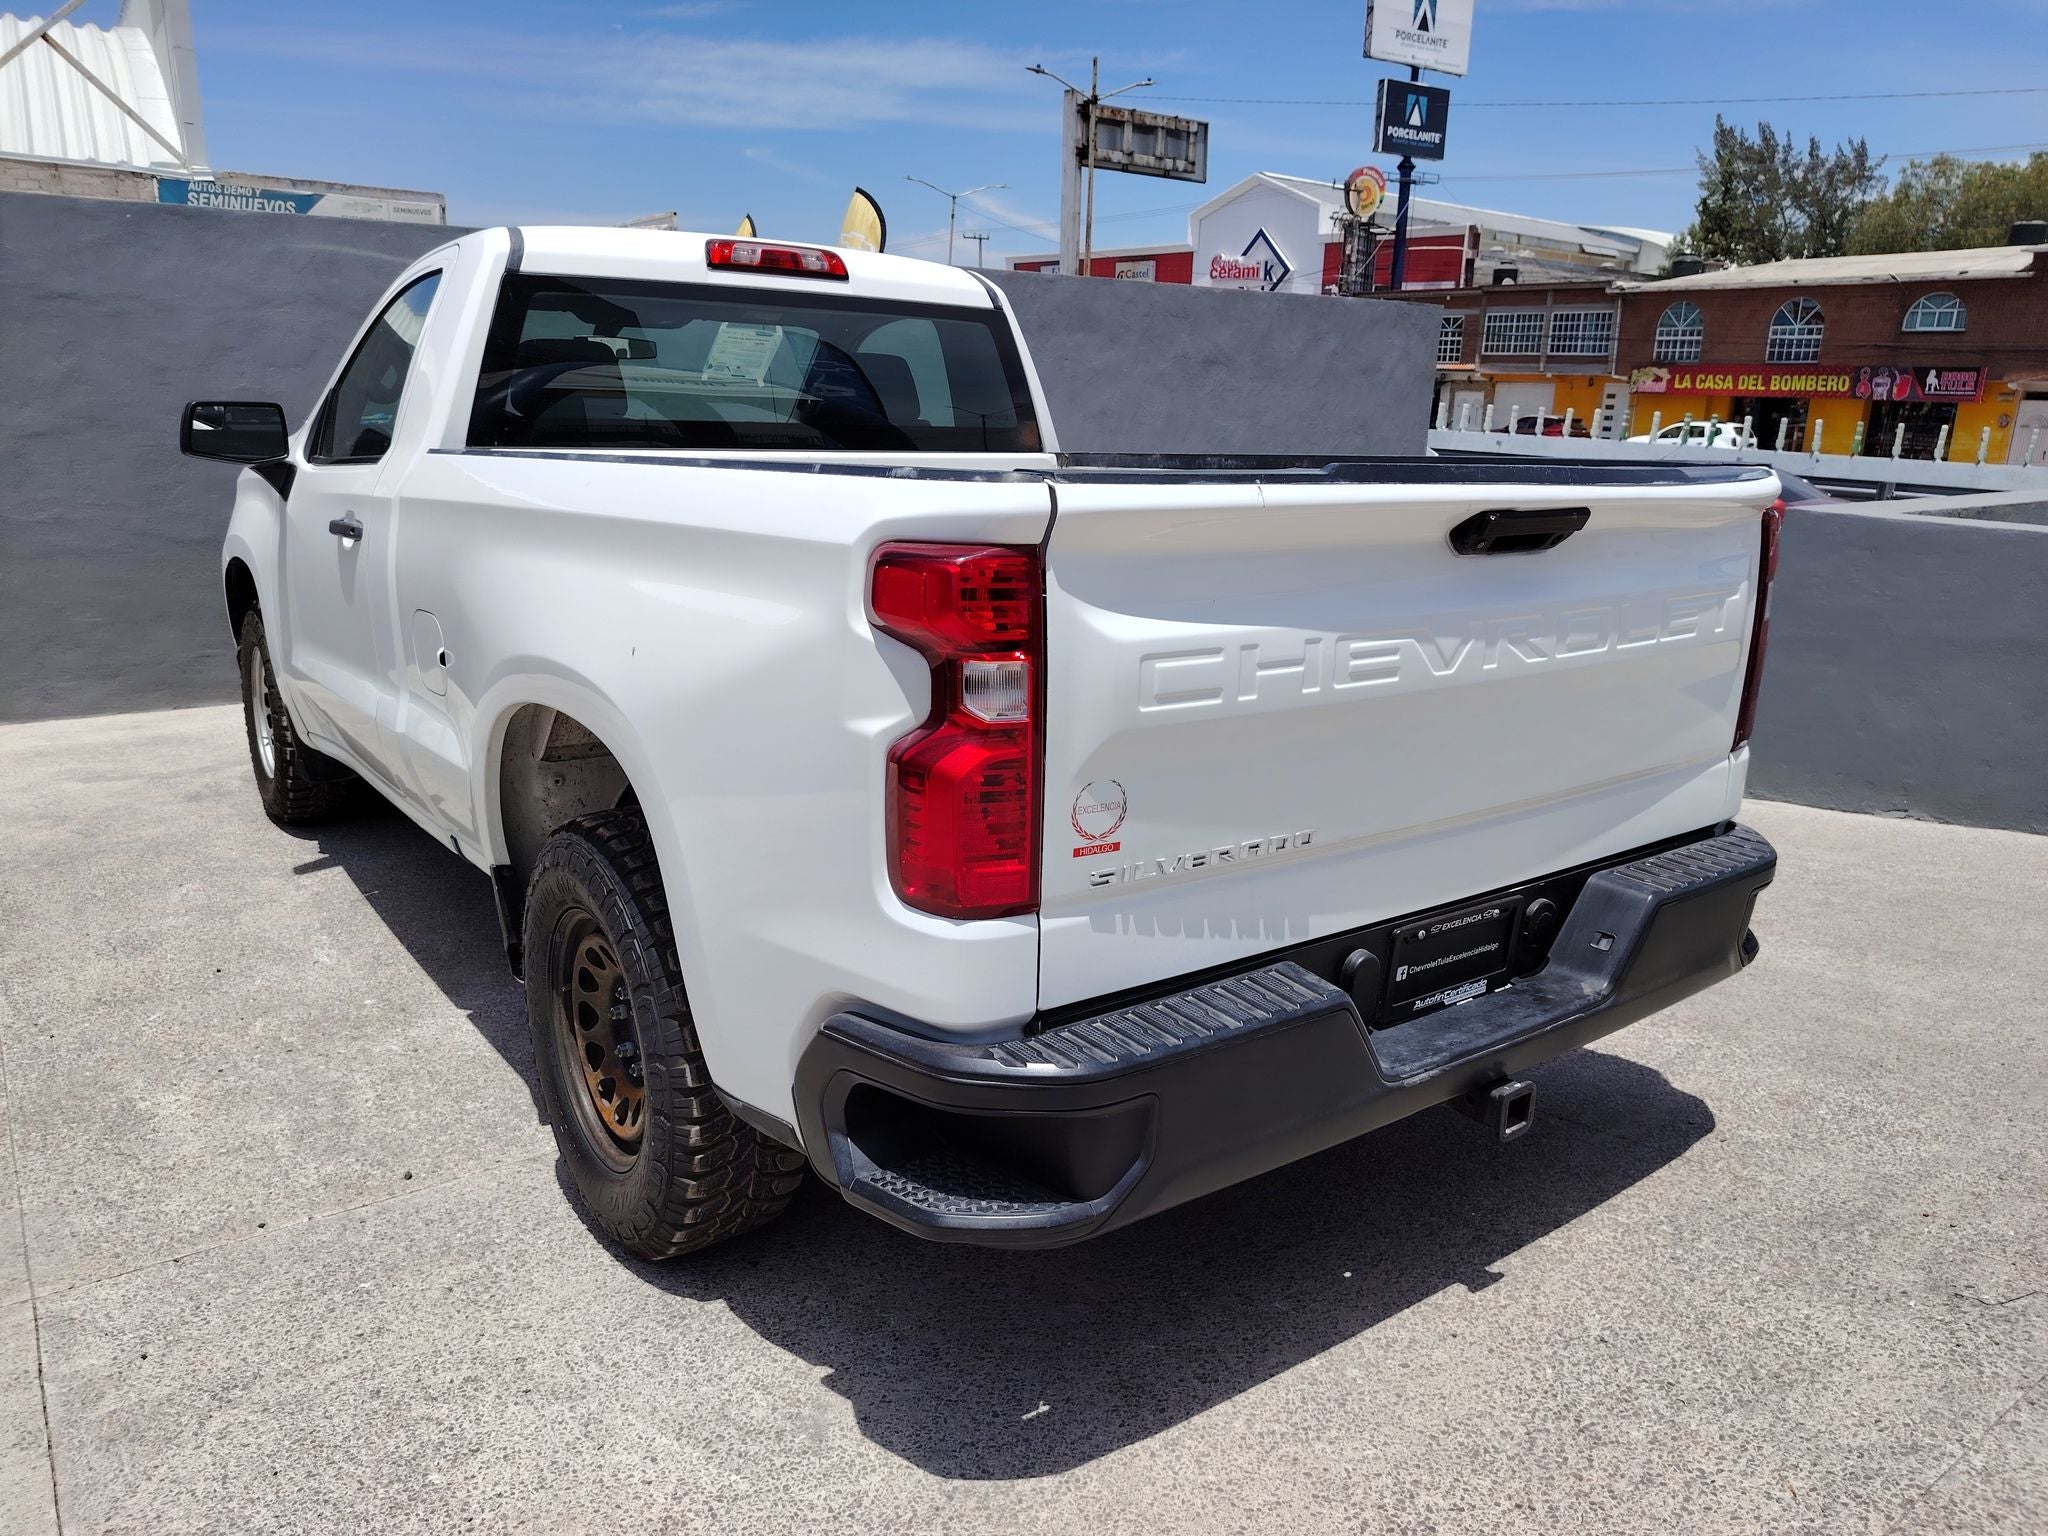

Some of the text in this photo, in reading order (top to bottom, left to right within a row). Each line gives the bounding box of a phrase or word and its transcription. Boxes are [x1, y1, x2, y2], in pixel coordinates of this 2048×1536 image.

[1395, 30, 1447, 49] PORCELANITE
[1387, 125, 1440, 144] PORCELANITE
[188, 180, 262, 197] AUTOS DEMO Y
[187, 191, 297, 214] SEMINUEVOS
[1125, 268, 1149, 279] Castel
[1674, 374, 1850, 392] LA CASA DEL BOMBERO
[1138, 590, 1746, 714] CHEVROLET
[1078, 801, 1121, 816] EXCELENCIA
[1080, 843, 1114, 856] HIDALGO
[1088, 828, 1317, 888] SILVERADO
[1441, 914, 1482, 931] EXCELENCIA
